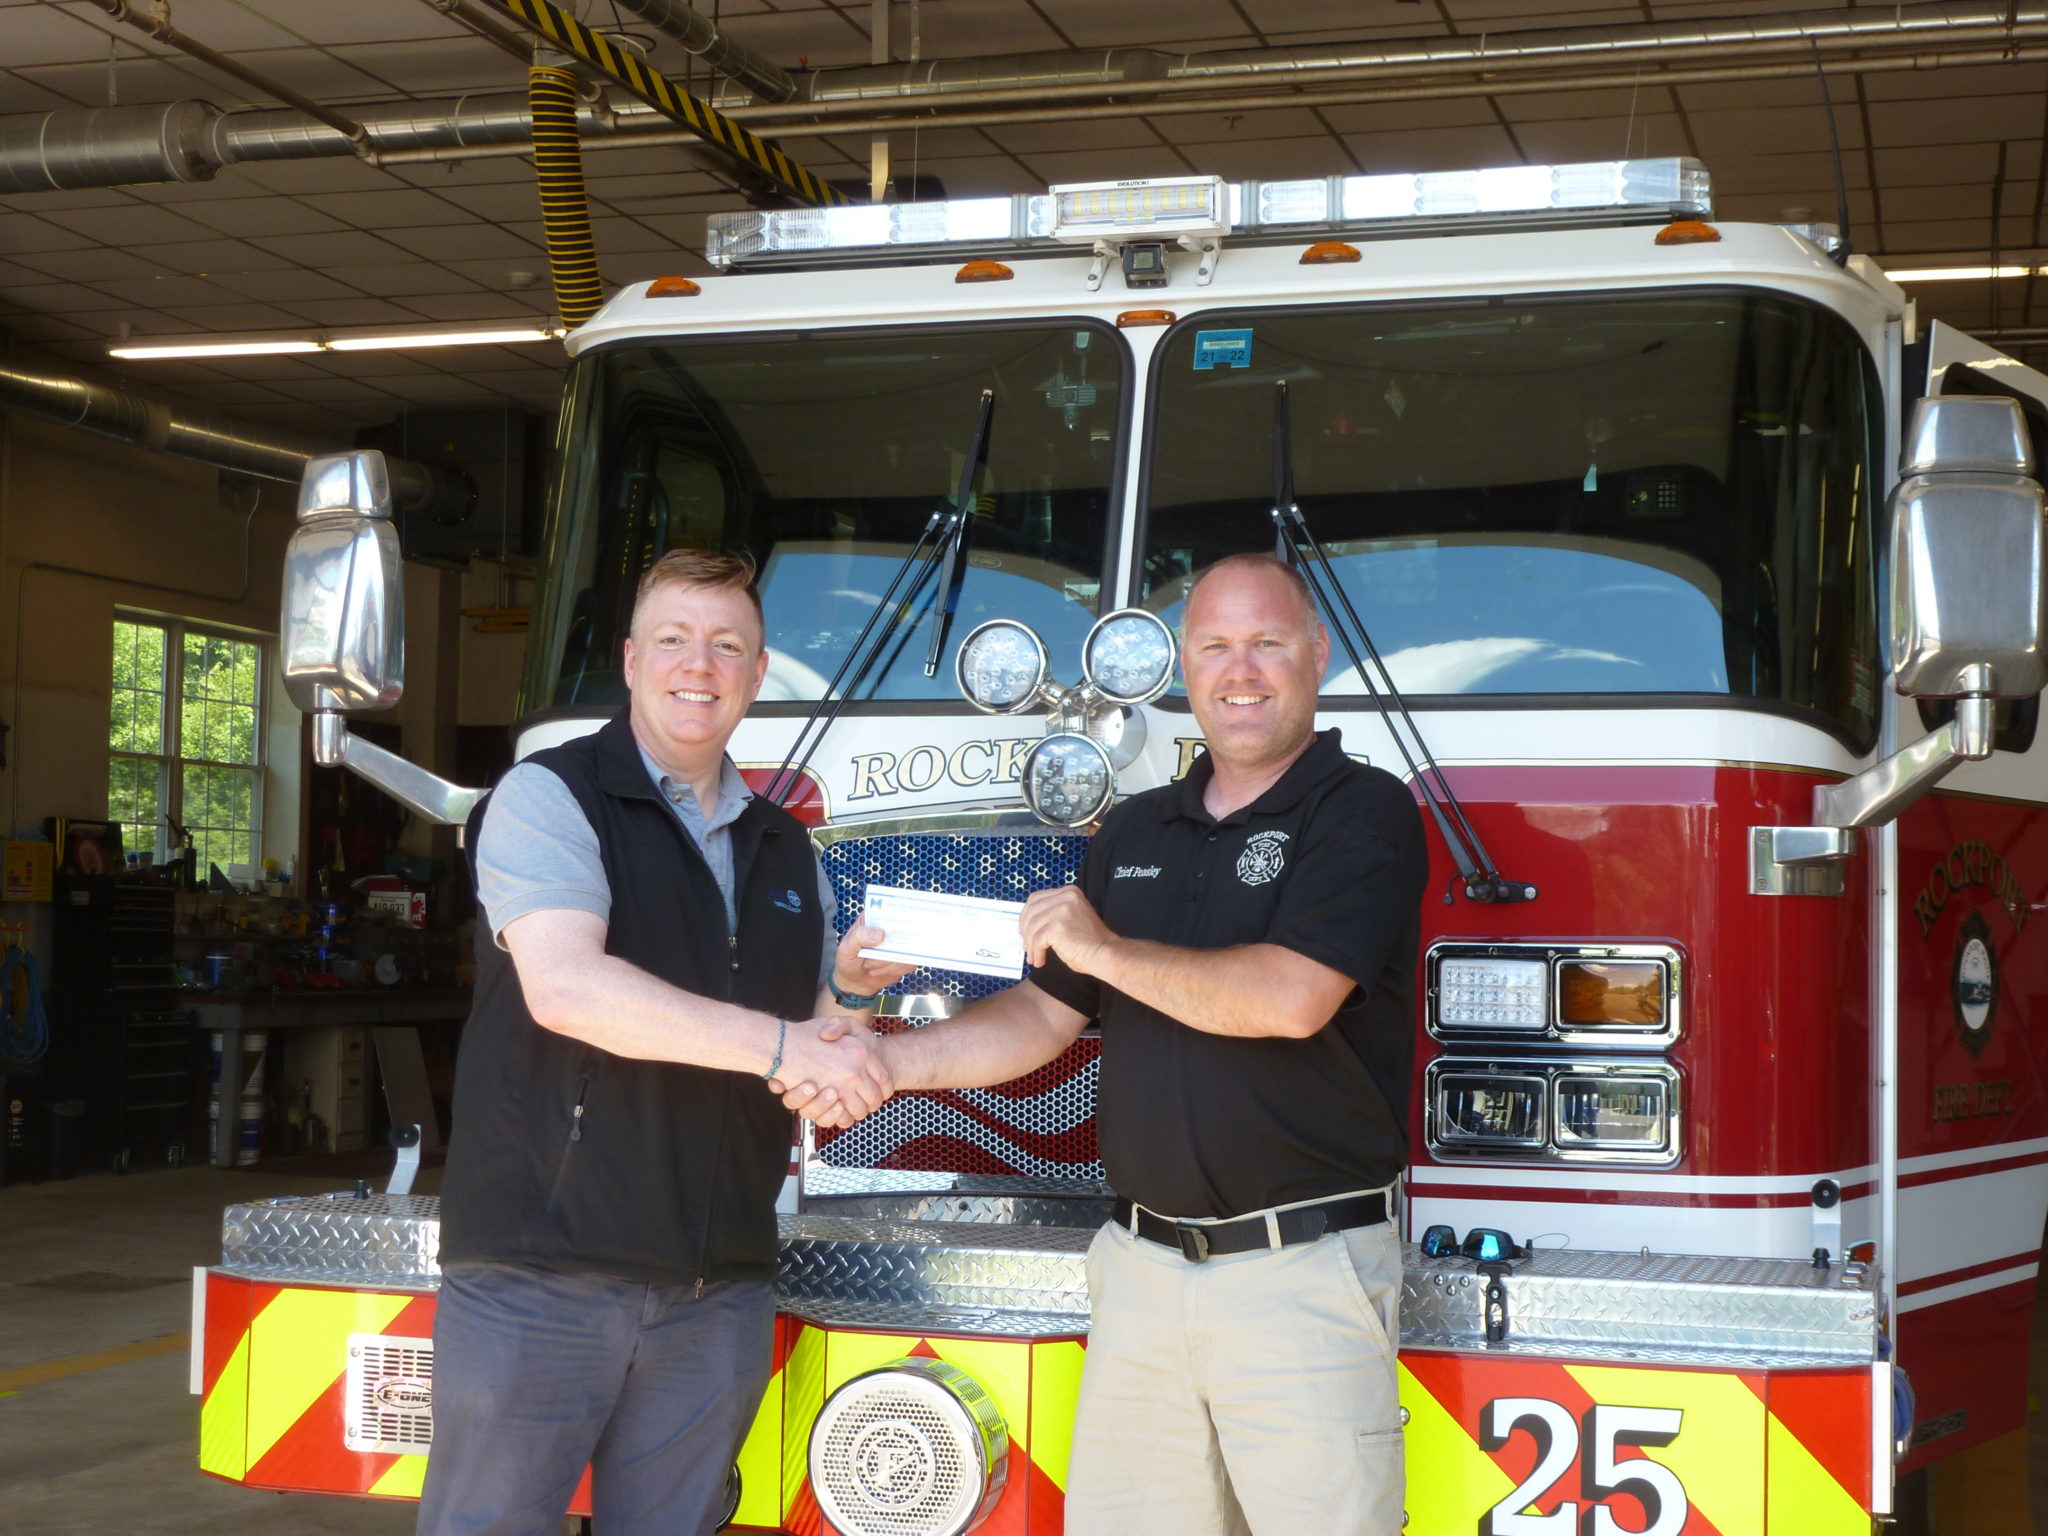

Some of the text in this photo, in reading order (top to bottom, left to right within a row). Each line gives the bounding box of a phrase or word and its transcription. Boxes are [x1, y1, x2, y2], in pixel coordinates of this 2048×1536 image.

[1201, 350, 1245, 362] 21 22
[1247, 830, 1290, 844] ROCKPORT
[1114, 865, 1134, 878] Chief
[1914, 840, 2031, 943] ROCKPORT
[1933, 1083, 1969, 1123] FIRE
[1478, 1397, 1688, 1536] 25
